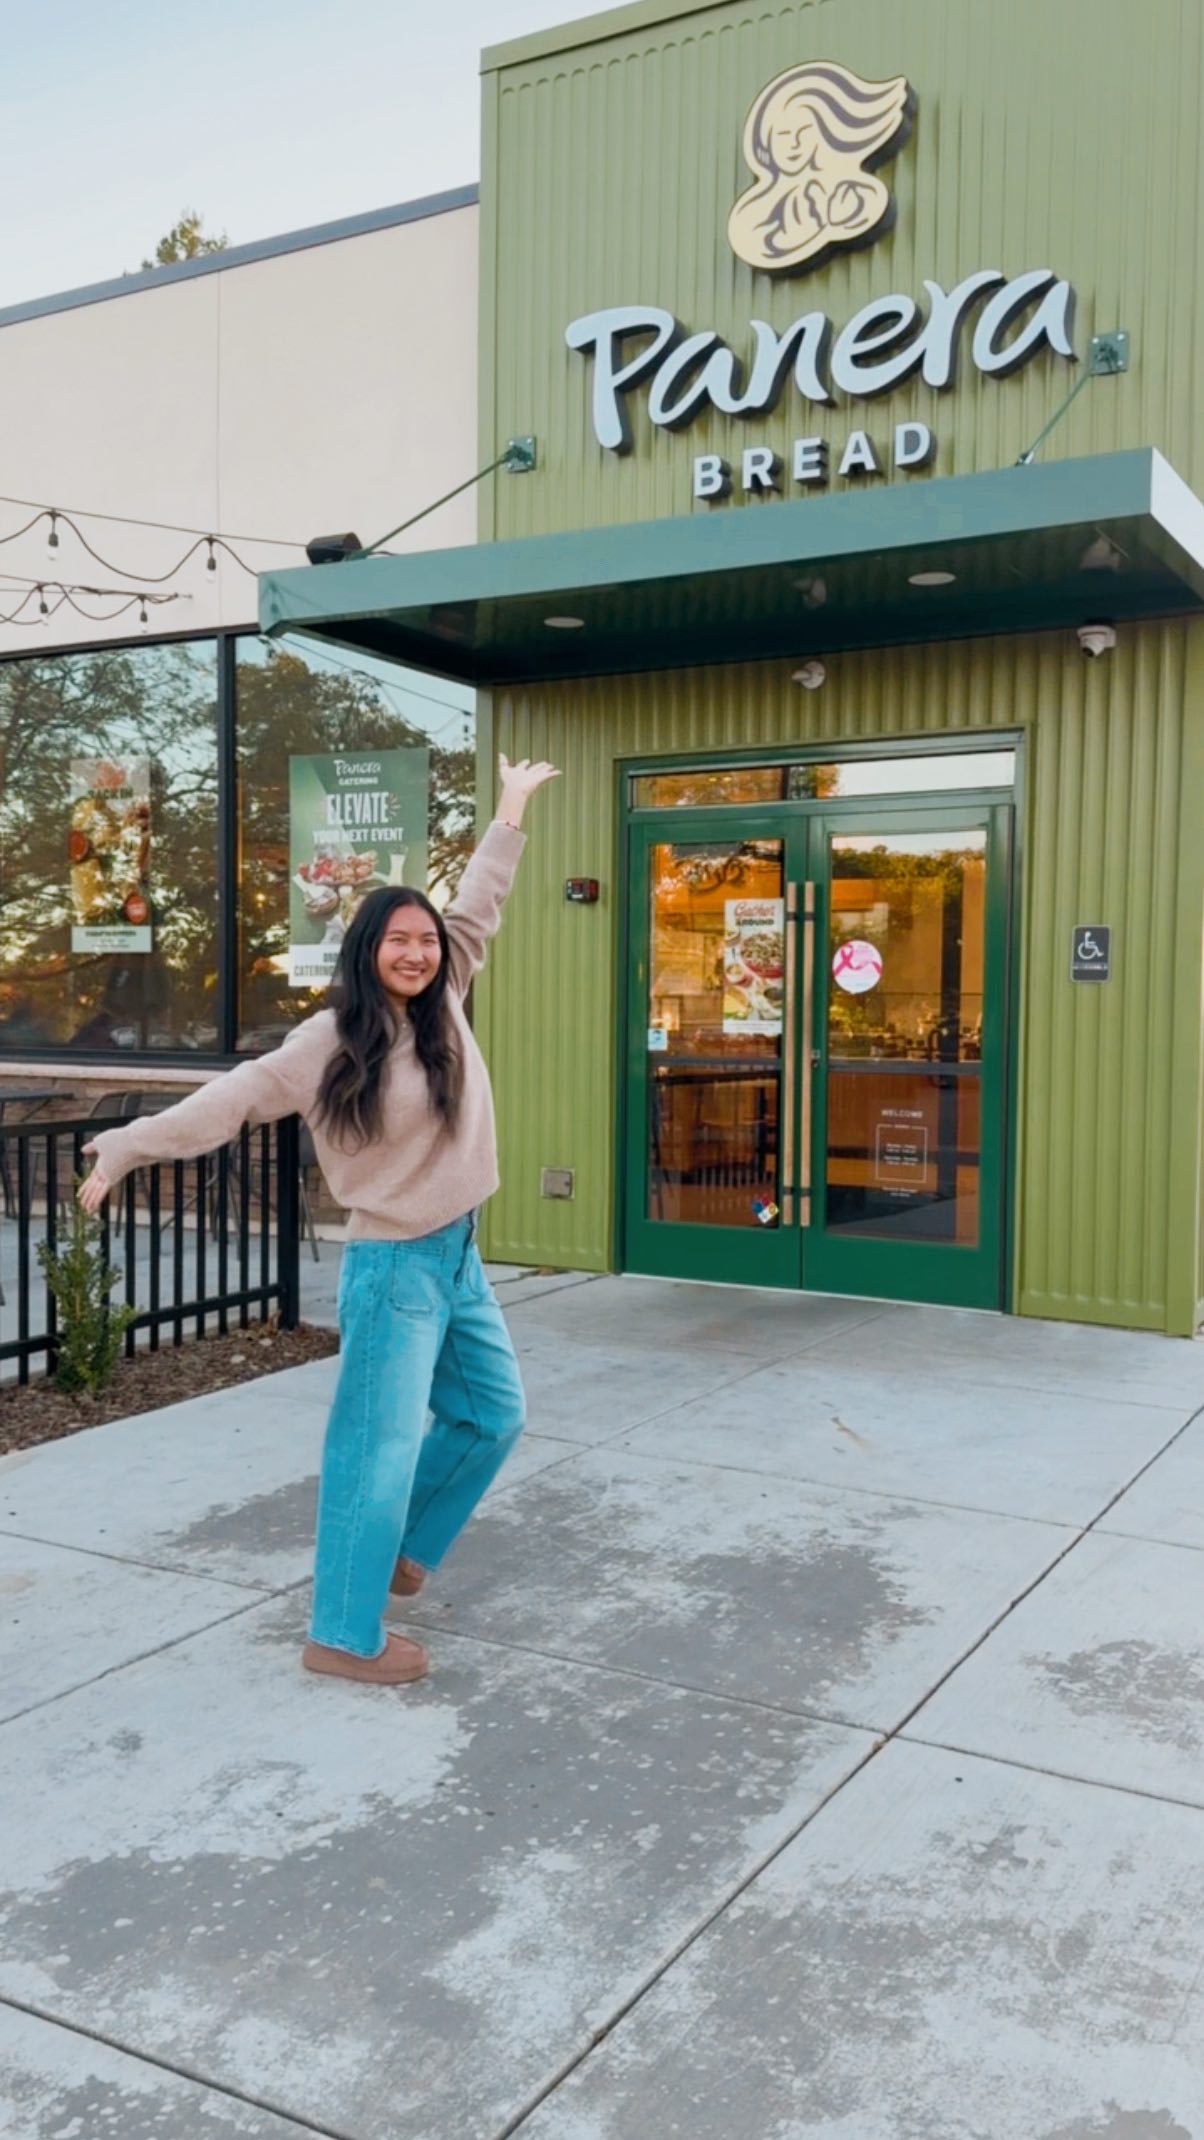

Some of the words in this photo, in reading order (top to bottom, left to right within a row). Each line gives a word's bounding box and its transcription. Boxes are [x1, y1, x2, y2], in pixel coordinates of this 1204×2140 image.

[564, 269, 1074, 450] Panera
[693, 421, 933, 499] BREAD
[333, 759, 381, 776] Panera
[338, 777, 379, 786] CATERING
[326, 791, 390, 826] ELEVATE
[312, 830, 340, 844] YOUR
[342, 829, 369, 843] NEXT
[371, 827, 404, 841] EVENT
[881, 1109, 923, 1118] WELCOME
